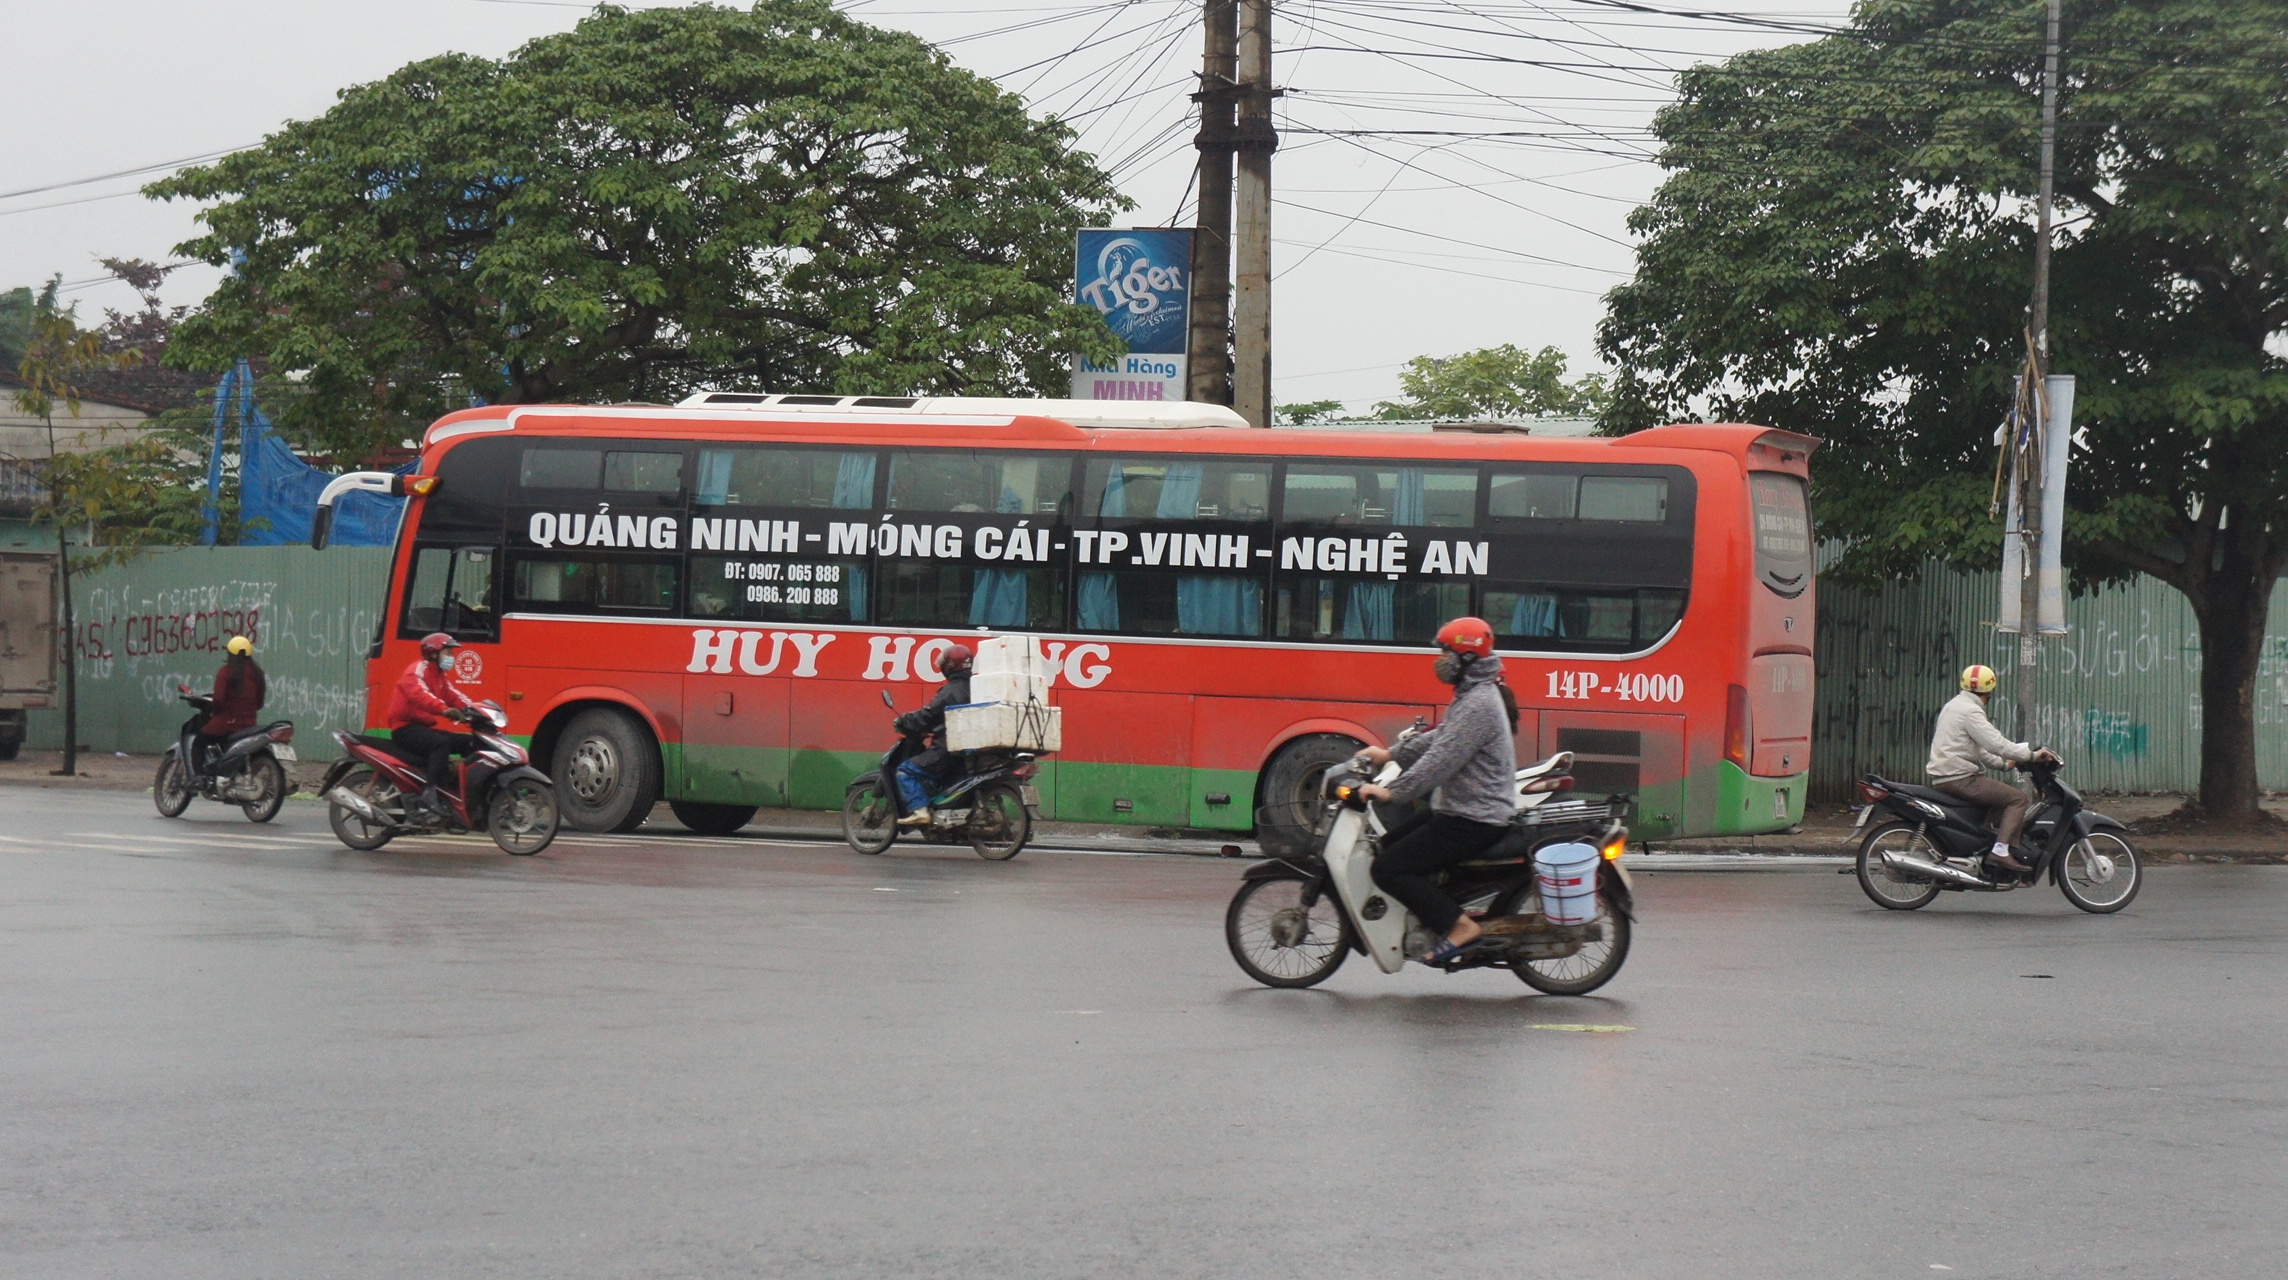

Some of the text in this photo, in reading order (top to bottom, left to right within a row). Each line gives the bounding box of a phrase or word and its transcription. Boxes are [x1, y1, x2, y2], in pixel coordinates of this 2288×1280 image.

[1081, 258, 1185, 315] Tiger
[1127, 358, 1177, 379] Hàng
[1093, 380, 1164, 401] MINH
[529, 503, 677, 549] QUẢNG
[1281, 532, 1408, 581] NGHỆ
[1421, 541, 1489, 575] AN
[725, 562, 840, 583] ĐT: 0907. 065 888
[747, 585, 839, 605] 0986. 200 888
[687, 629, 836, 678] HUY
[1546, 670, 1684, 703] 14P-4000
